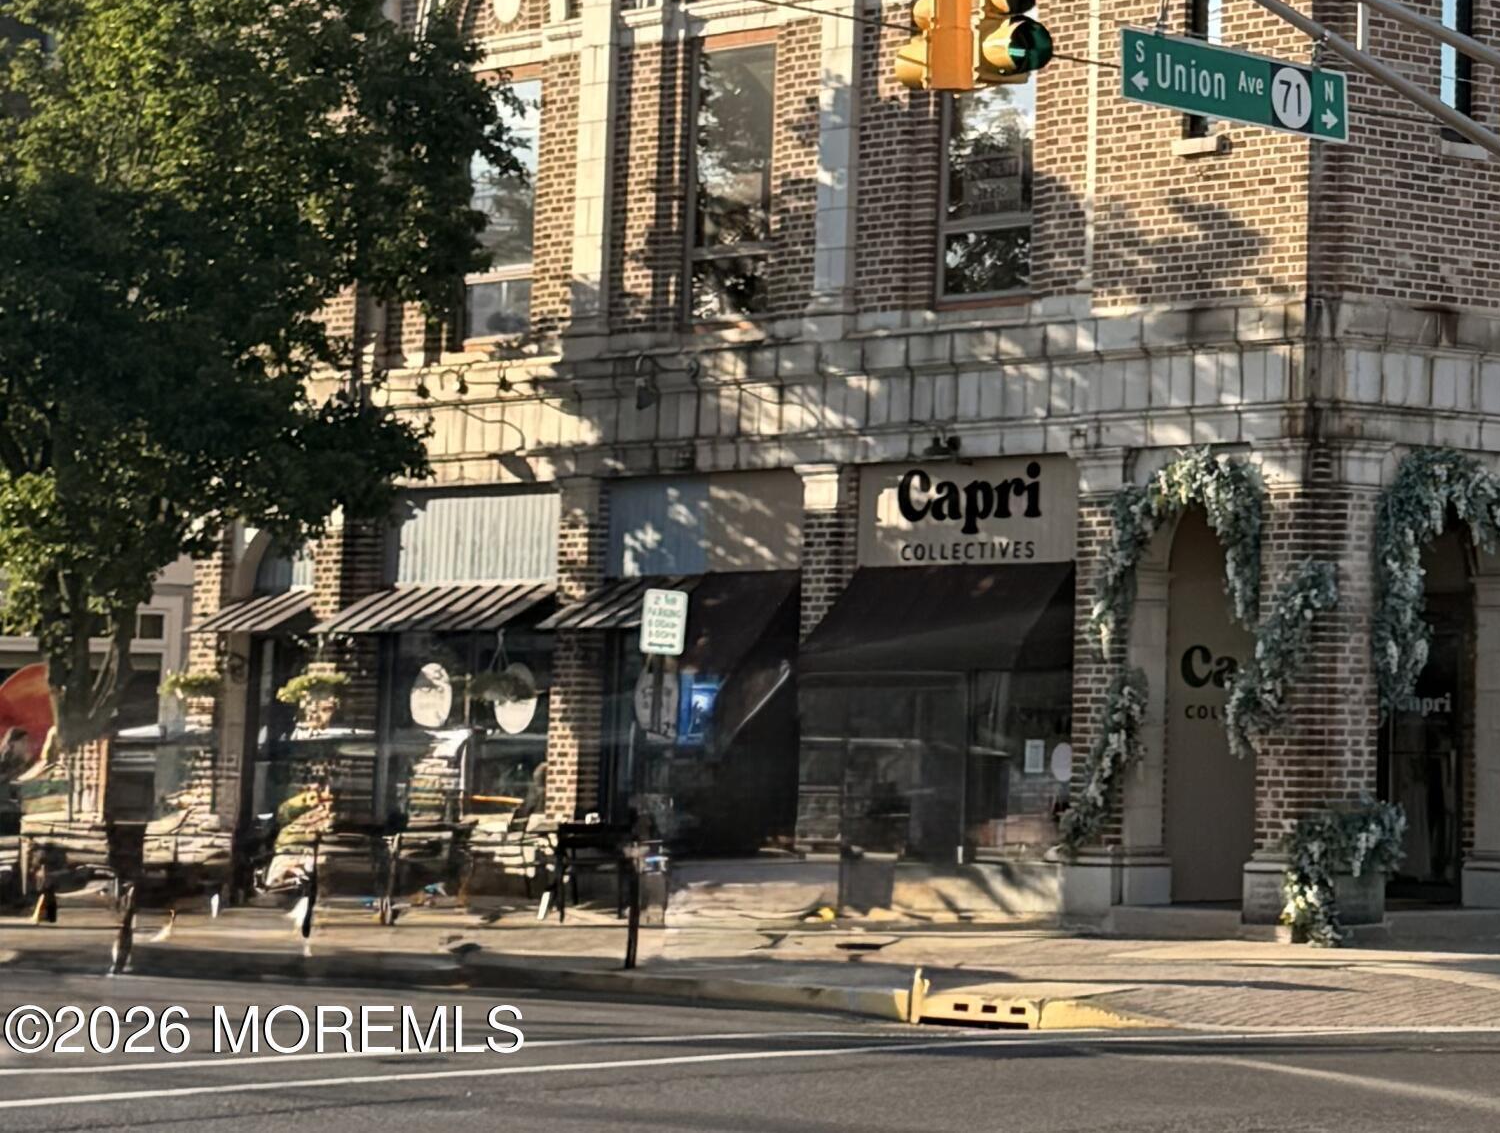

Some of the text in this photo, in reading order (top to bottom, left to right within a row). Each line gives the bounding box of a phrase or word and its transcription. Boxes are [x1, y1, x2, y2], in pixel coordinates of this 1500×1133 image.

[1135, 39, 1146, 63] S
[1156, 52, 1264, 101] Union Ave
[1324, 80, 1335, 103] N
[1278, 79, 1302, 117] 71
[897, 461, 1042, 535] Capri
[901, 541, 1036, 562] COLLECTIVES
